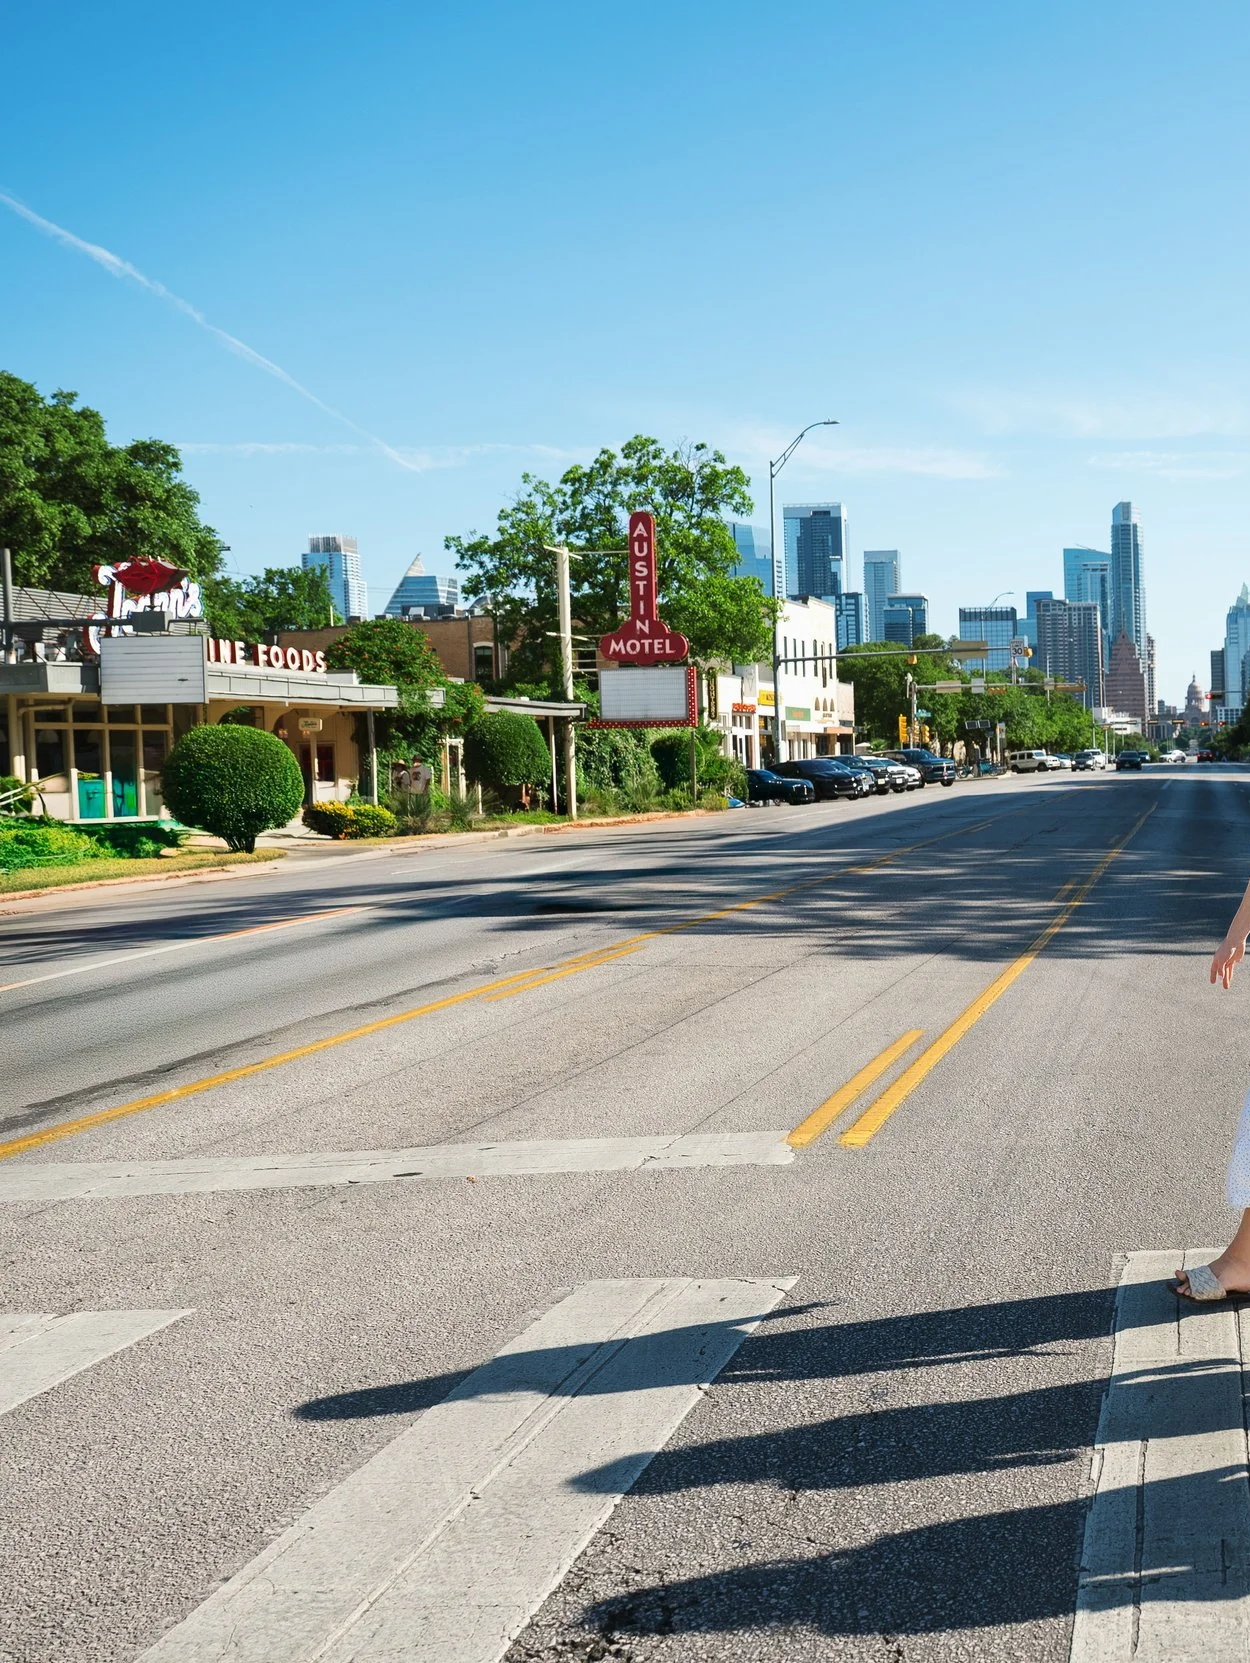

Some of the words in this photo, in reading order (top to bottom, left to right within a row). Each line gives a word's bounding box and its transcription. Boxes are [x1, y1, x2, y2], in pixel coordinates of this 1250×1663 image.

[633, 521, 650, 635] AUSTIN
[208, 637, 245, 665] INE
[257, 643, 327, 673] FOODS
[609, 638, 676, 655] MOTEL
[1012, 647, 1023, 655] 30
